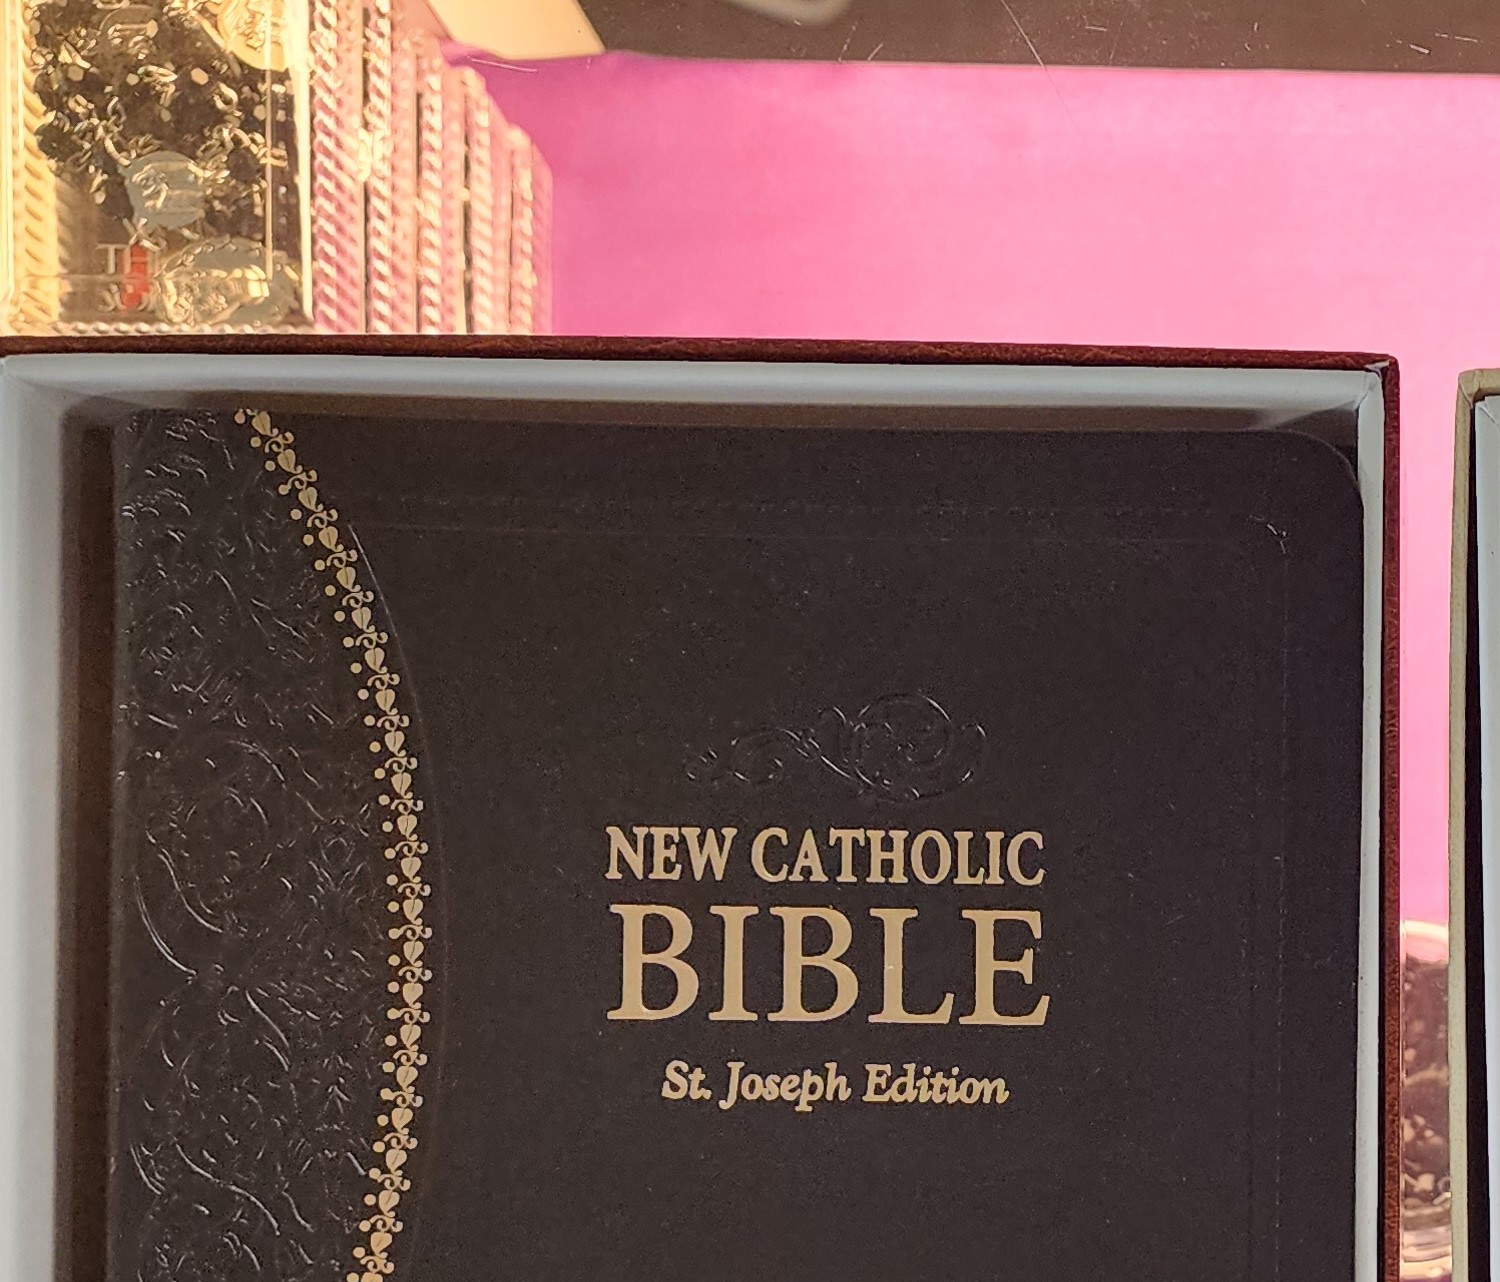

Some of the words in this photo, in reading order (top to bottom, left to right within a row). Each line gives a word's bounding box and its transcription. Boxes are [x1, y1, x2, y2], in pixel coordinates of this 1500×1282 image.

[604, 826, 738, 881] NEW
[751, 827, 1047, 886] CATHOLIC
[606, 903, 1051, 1026] BIBLE
[661, 1059, 713, 1100] St.
[718, 1061, 852, 1112] Joseph
[861, 1062, 1010, 1105] Edition
